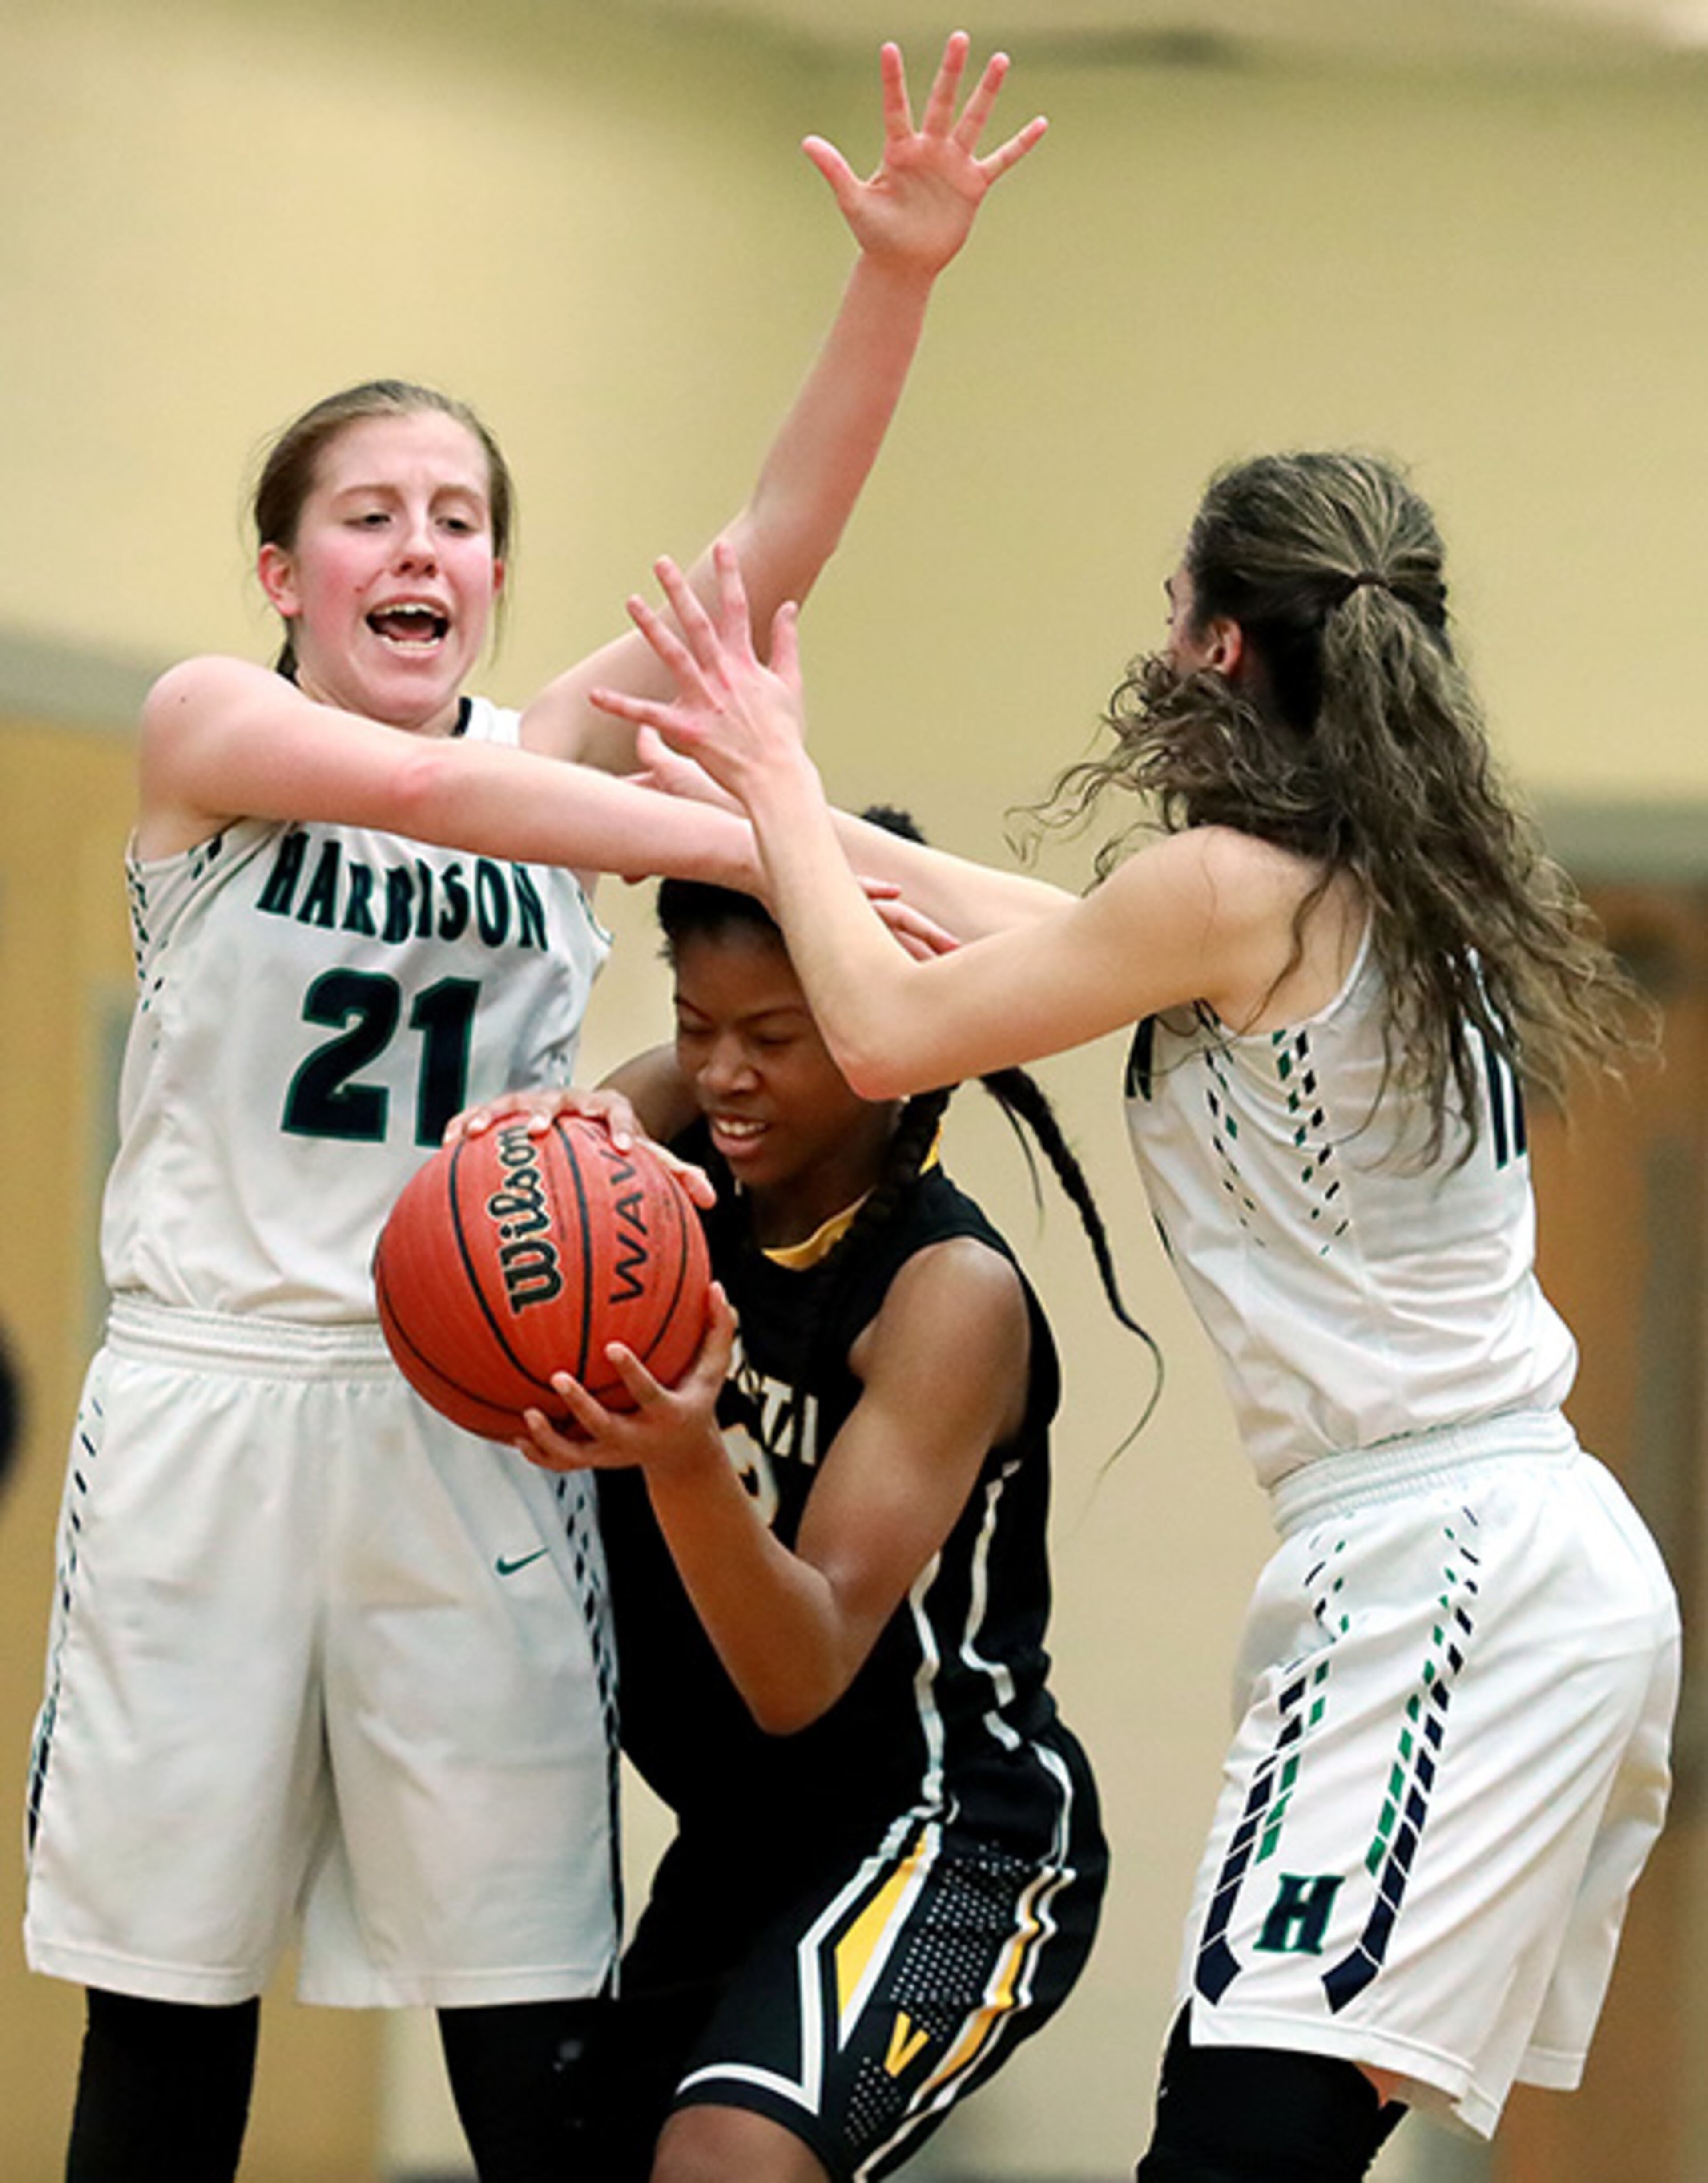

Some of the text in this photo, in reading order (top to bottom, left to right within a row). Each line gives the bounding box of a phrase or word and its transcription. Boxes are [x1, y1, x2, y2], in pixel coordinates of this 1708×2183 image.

[281, 967, 482, 1148] 21
[487, 1124, 564, 1314] Wilson
[1253, 1872, 1345, 1956] H
[884, 2010, 931, 2078] V
